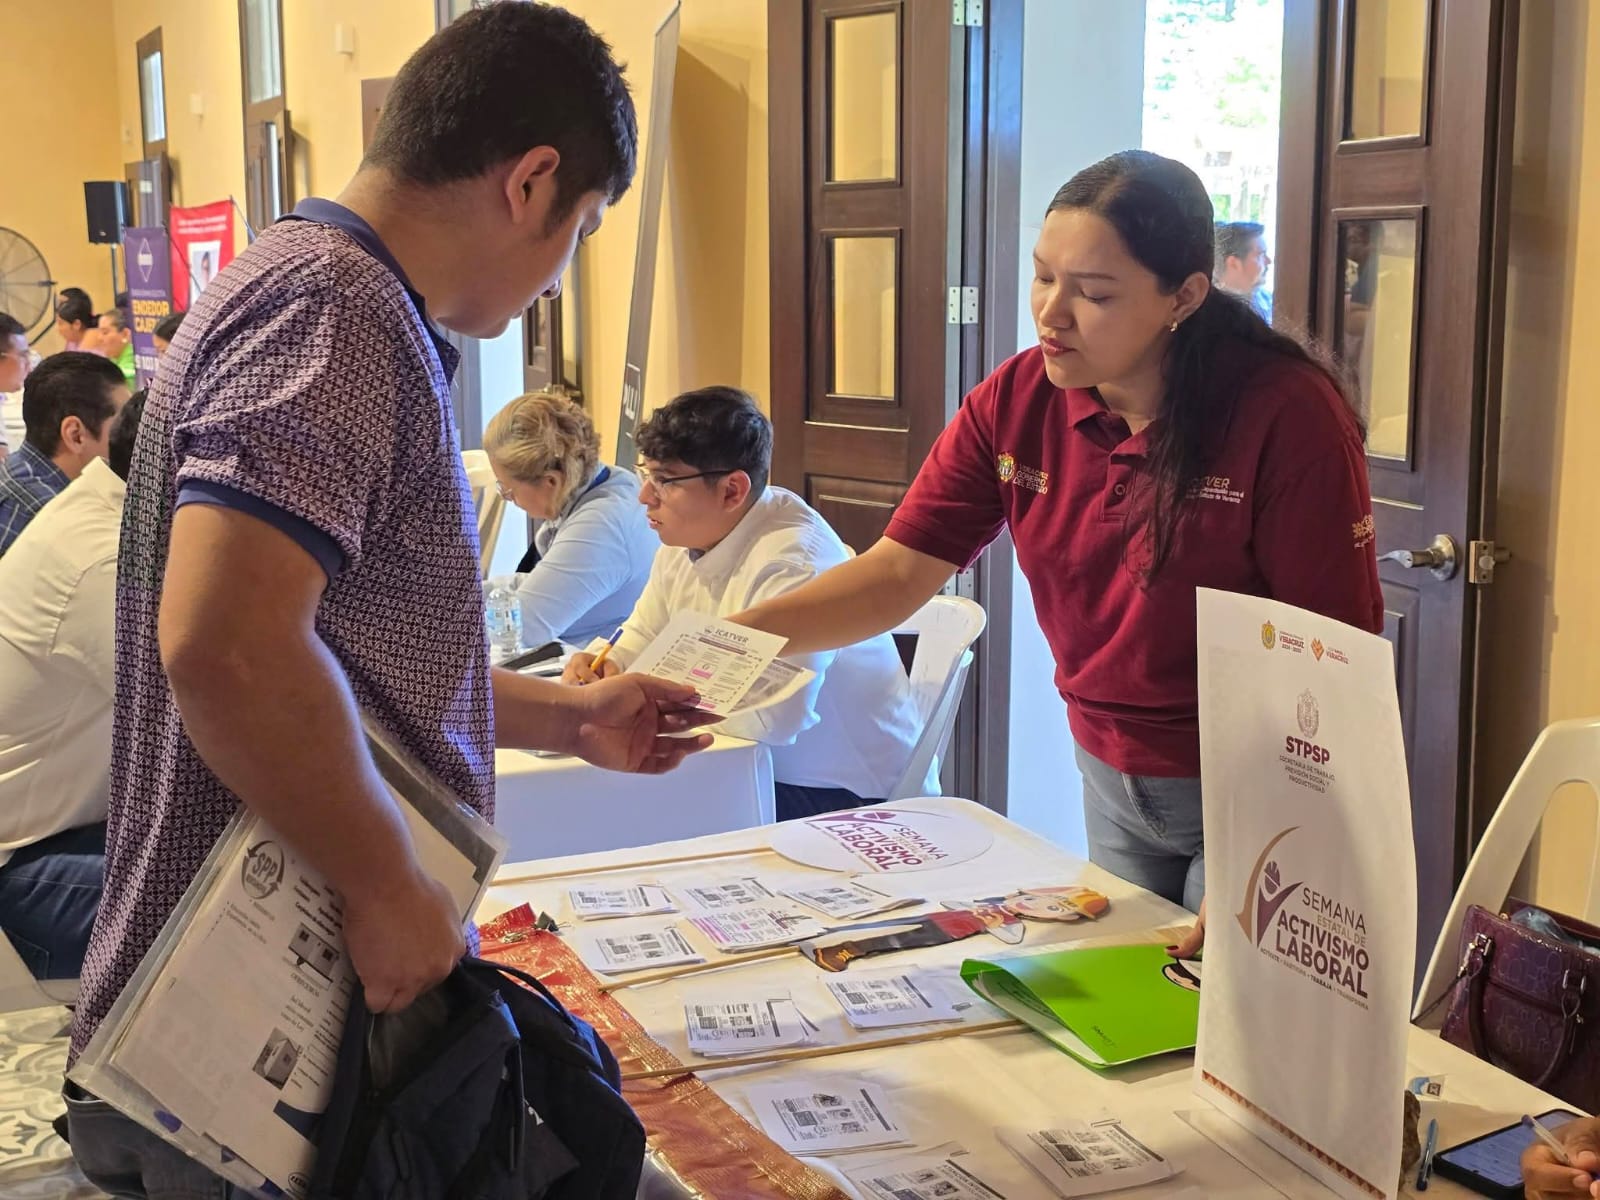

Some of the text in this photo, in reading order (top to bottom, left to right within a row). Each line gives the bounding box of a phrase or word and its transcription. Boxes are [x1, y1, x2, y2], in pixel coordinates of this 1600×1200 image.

[1286, 736, 1330, 765] STPSP
[250, 851, 278, 881] SPP
[825, 823, 901, 871] LABORAL
[847, 822, 923, 866] ACTIVISMO
[893, 827, 949, 861] SEMANA
[1302, 887, 1367, 935] SEMANA
[1317, 914, 1366, 948] ESTATAL DE
[1277, 909, 1370, 971] ACTIVISMO
[1276, 929, 1369, 999] LABORAL
